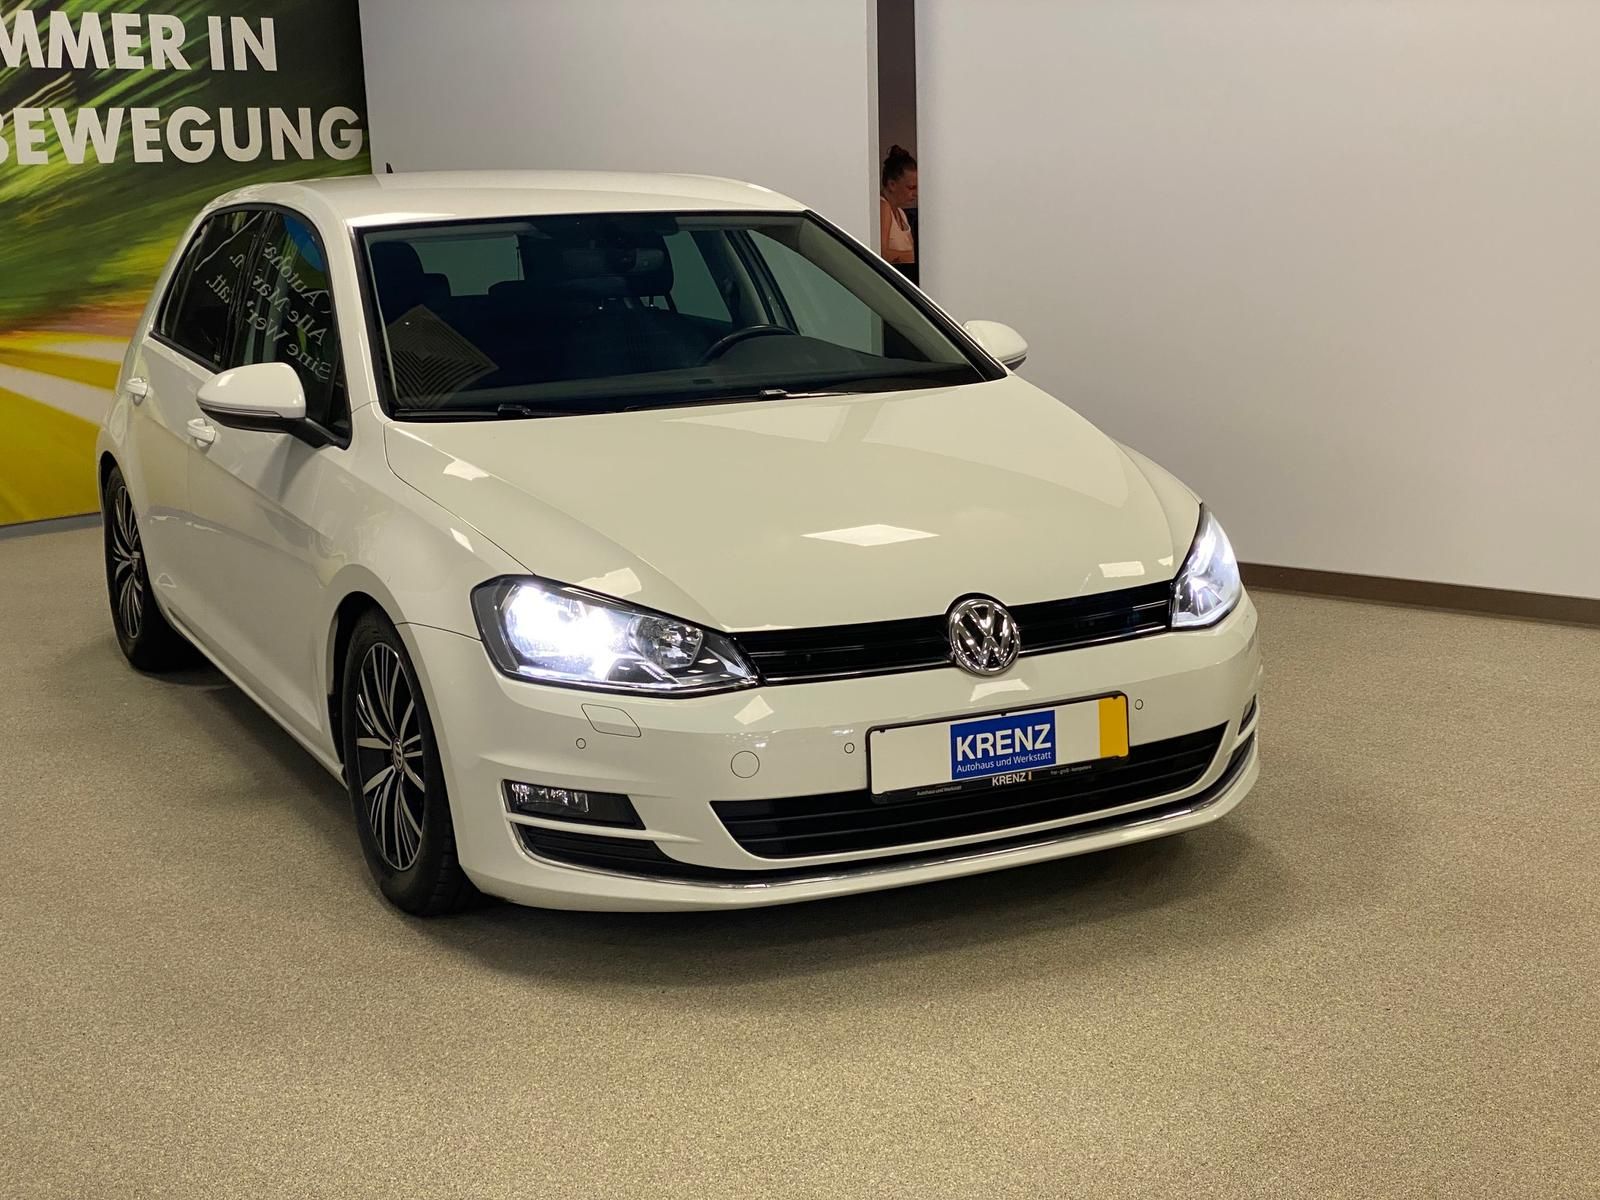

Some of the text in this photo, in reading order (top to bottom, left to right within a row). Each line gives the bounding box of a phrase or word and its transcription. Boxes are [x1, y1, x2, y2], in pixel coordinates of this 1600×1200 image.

[207, 15, 278, 72] IN
[0, 105, 363, 165] EWEGUNG
[956, 723, 1052, 762] KRENZ
[956, 751, 1052, 773] Autohaus und Werkstatt
[991, 772, 1026, 787] KRENZ
